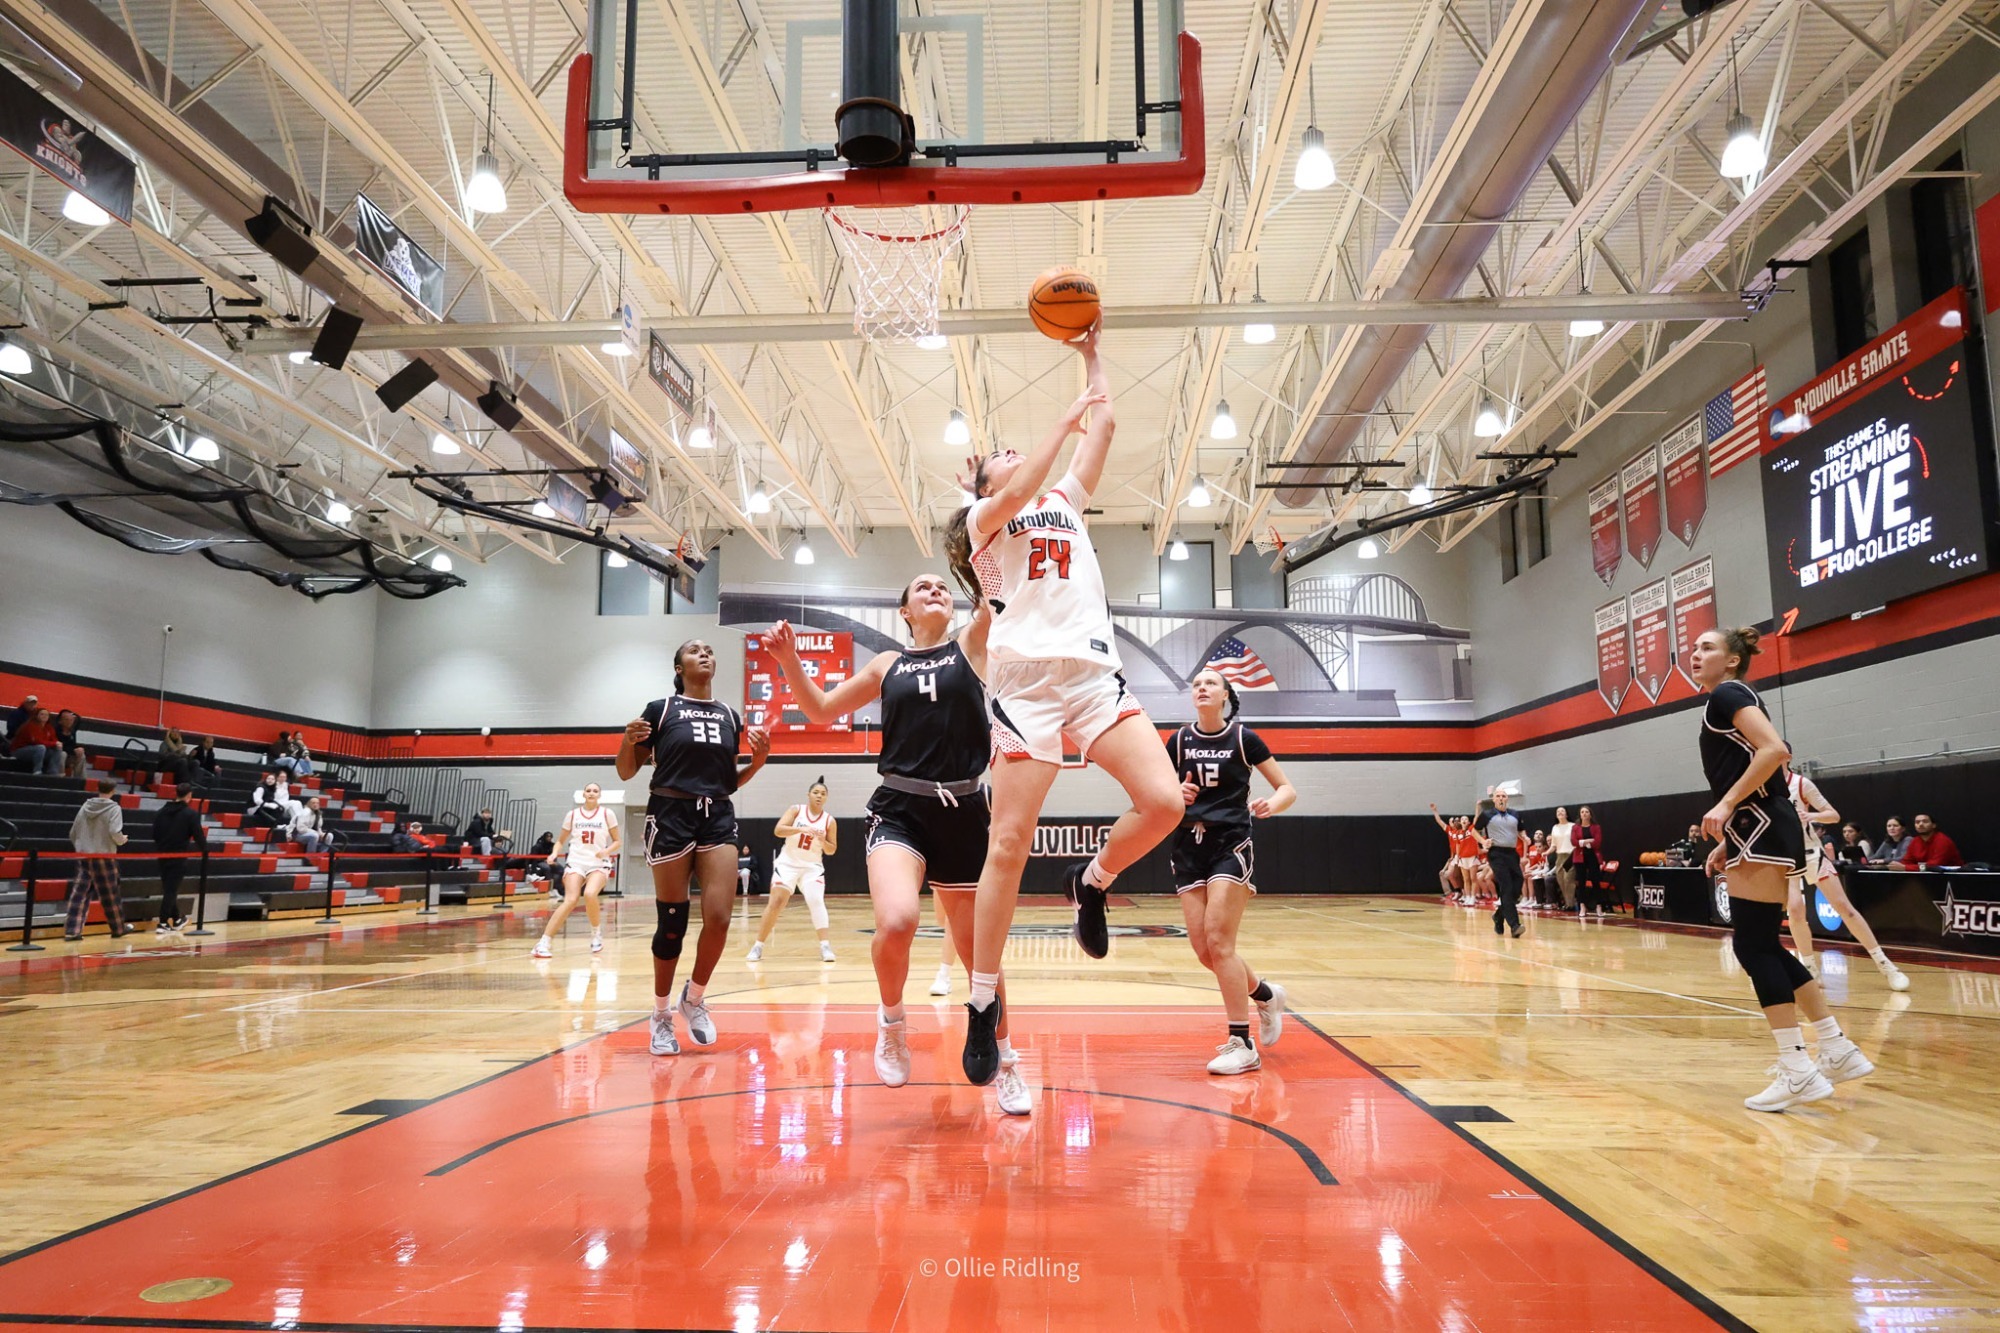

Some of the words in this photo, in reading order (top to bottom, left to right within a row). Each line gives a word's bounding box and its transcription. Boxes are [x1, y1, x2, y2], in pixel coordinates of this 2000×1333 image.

[36, 144, 88, 188] KNIGHTS
[1824, 439, 1846, 462] THIS
[1846, 426, 1875, 451] GAME
[1875, 418, 1887, 435] IS
[1810, 423, 1910, 495] STREAMING
[1811, 452, 1911, 560] LIVE
[1827, 516, 1932, 577] FLOCOLLEGE
[1028, 538, 1071, 580] 24
[894, 654, 957, 676] MOLLOY
[752, 673, 771, 681] HOME
[825, 672, 846, 681] GUEST
[917, 673, 938, 702] 4
[762, 683, 773, 702] 5
[679, 709, 725, 721] MOLLOY
[754, 711, 764, 725] 0
[691, 721, 722, 744] 33
[1184, 748, 1234, 760] MOLLOY
[1196, 763, 1219, 788] 12
[581, 830, 595, 845] 21
[798, 833, 814, 851] 15
[1643, 887, 1665, 906] ECC
[1952, 904, 2000, 933] ECC
